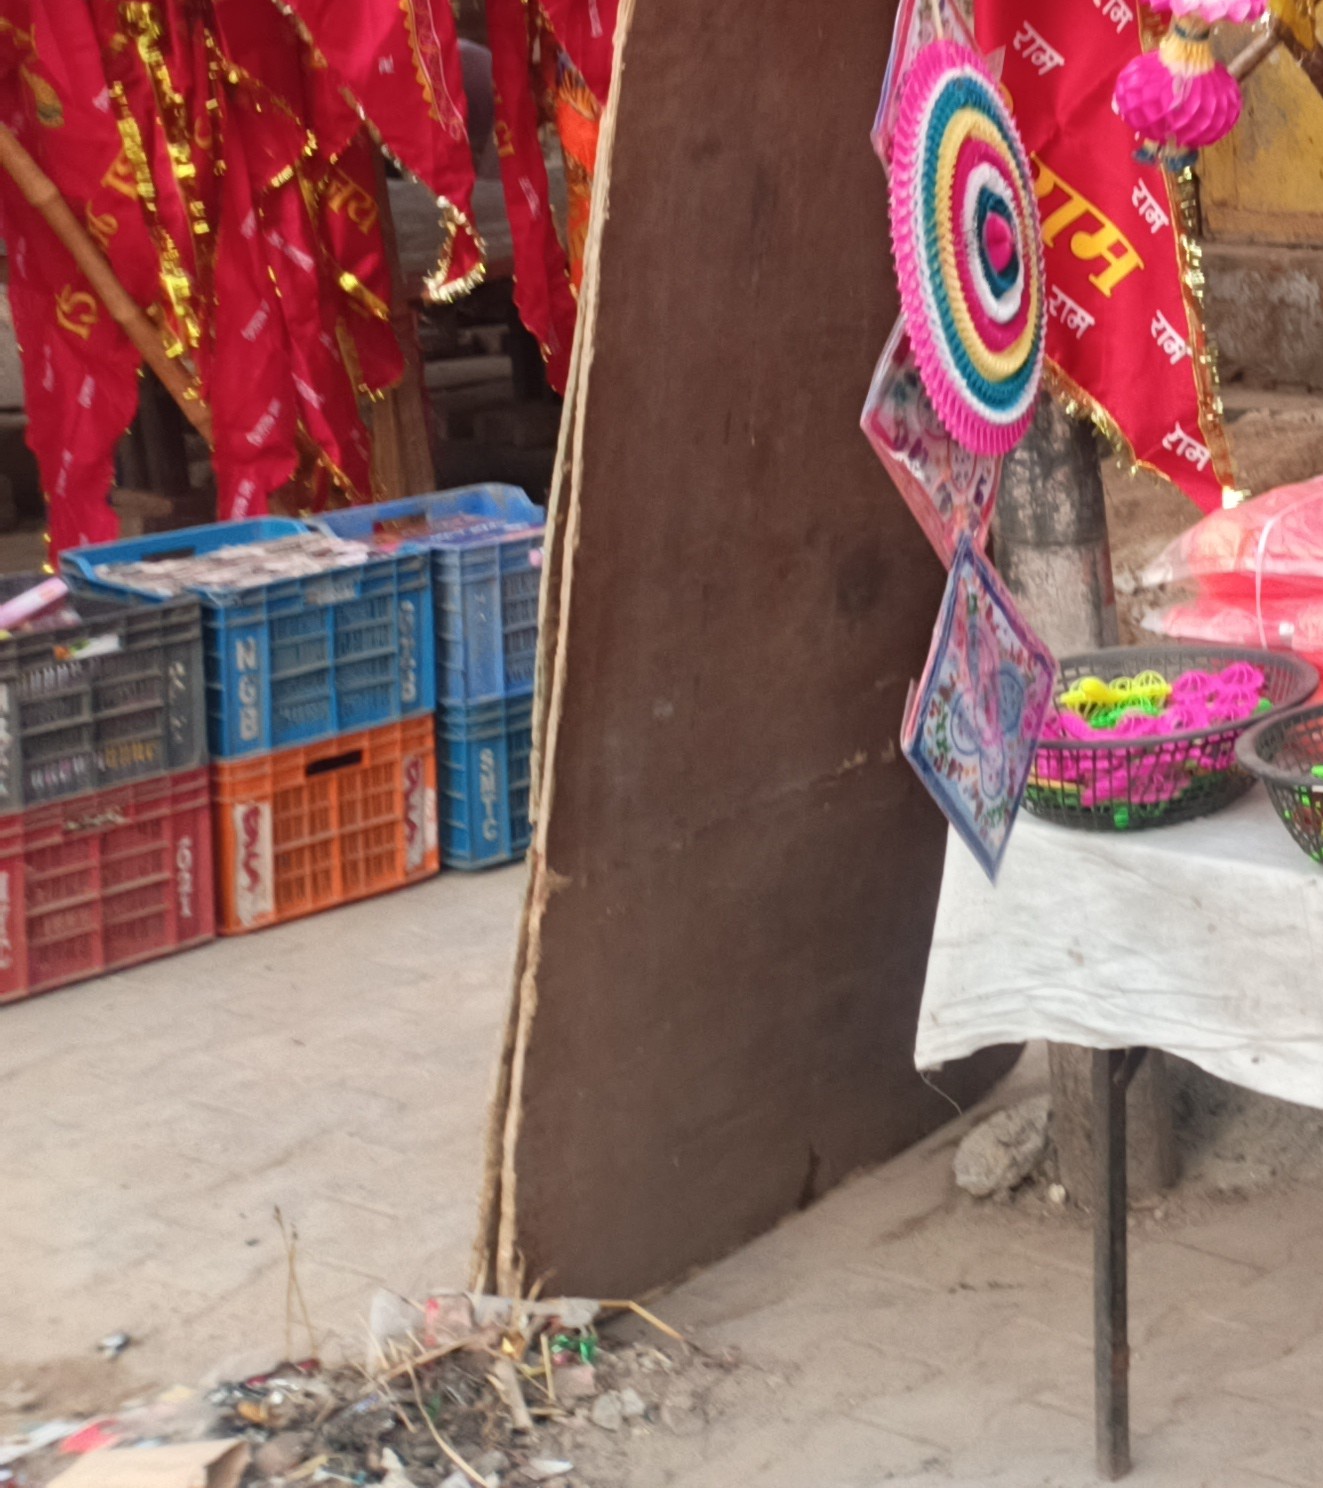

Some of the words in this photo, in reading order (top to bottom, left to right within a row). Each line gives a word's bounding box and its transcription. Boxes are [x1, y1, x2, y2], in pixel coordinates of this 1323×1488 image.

[1012, 20, 1066, 77] राम
[1131, 178, 1170, 235] राम
[1047, 283, 1096, 340] राम
[1150, 309, 1194, 366] राम
[1161, 422, 1212, 472] राम
